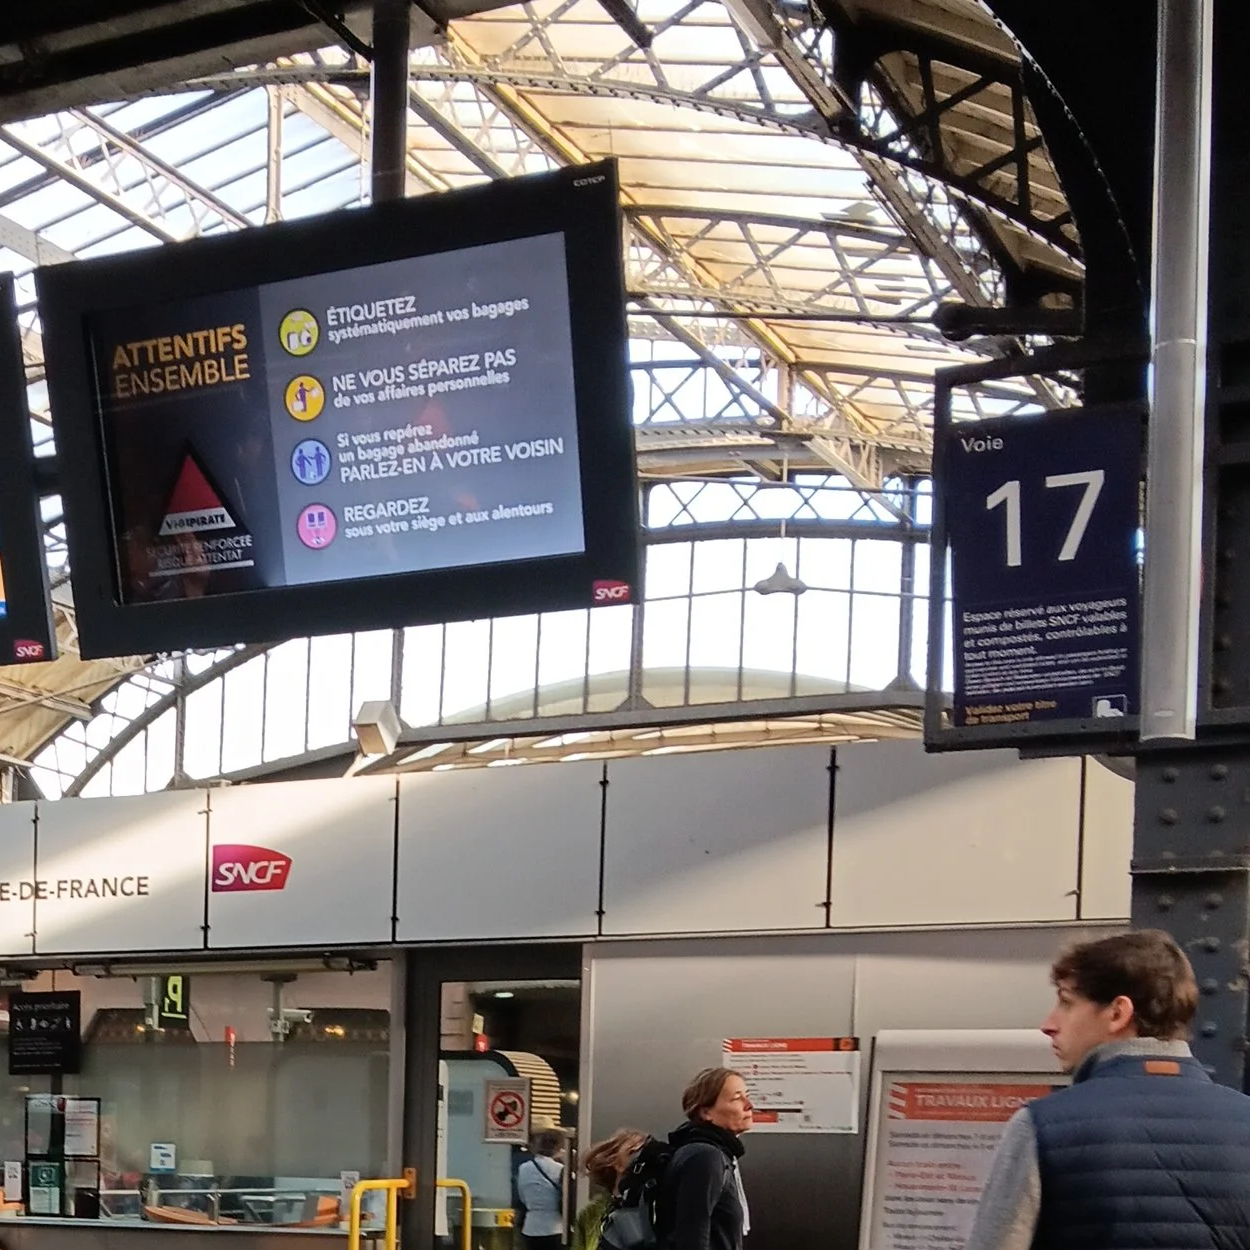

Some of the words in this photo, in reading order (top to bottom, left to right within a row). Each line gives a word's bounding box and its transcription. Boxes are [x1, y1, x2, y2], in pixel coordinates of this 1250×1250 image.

[327, 295, 416, 326] ÉTIQUETEZ
[328, 310, 444, 344] systématiquement
[446, 307, 469, 322] vos
[471, 298, 529, 320] bagages
[113, 323, 248, 370] ATTENTIFS
[115, 354, 250, 399] ENSEMBLE
[332, 374, 357, 392] NE
[359, 366, 405, 388] VOUS
[408, 354, 480, 381] SÉPAREZ
[484, 348, 517, 369] PAS
[333, 393, 351, 409] de
[353, 391, 375, 405] vos
[377, 382, 426, 402] affaires
[428, 370, 510, 397] personnelles
[336, 433, 349, 448] Si
[351, 431, 381, 446] vous
[383, 424, 433, 441] repérez
[338, 451, 354, 464] un
[357, 443, 404, 463] bagage
[407, 430, 479, 454] abandonné
[961, 436, 1003, 453] Voie
[341, 456, 426, 483] PARLEZ-EN
[429, 451, 444, 472] À
[446, 446, 502, 468] VOTRE
[506, 437, 564, 461] VOISIN
[343, 497, 430, 522] REGARDEZ
[345, 526, 374, 539] sous
[375, 520, 409, 536] votre
[411, 515, 446, 532] siège
[448, 511, 463, 525] et
[465, 510, 489, 524] aux
[491, 501, 554, 521] alentours
[986, 469, 1106, 567] 17
[594, 585, 629, 600] SNCF
[963, 611, 1002, 623] Espace
[1004, 605, 1045, 618] réservé
[1046, 603, 1067, 614] aux
[1069, 598, 1127, 612] voyageurs
[963, 624, 997, 635] munis
[999, 622, 1013, 632] de
[1015, 619, 1047, 631] billets
[1049, 614, 1081, 627] SNCF
[1082, 611, 1127, 624] valables
[964, 638, 975, 648] et
[1119, 622, 1128, 633] à
[15, 644, 44, 658] SNCF
[964, 650, 986, 661] tout
[215, 860, 287, 887] SNCF
[914, 1094, 987, 1109] TRAVAUX
